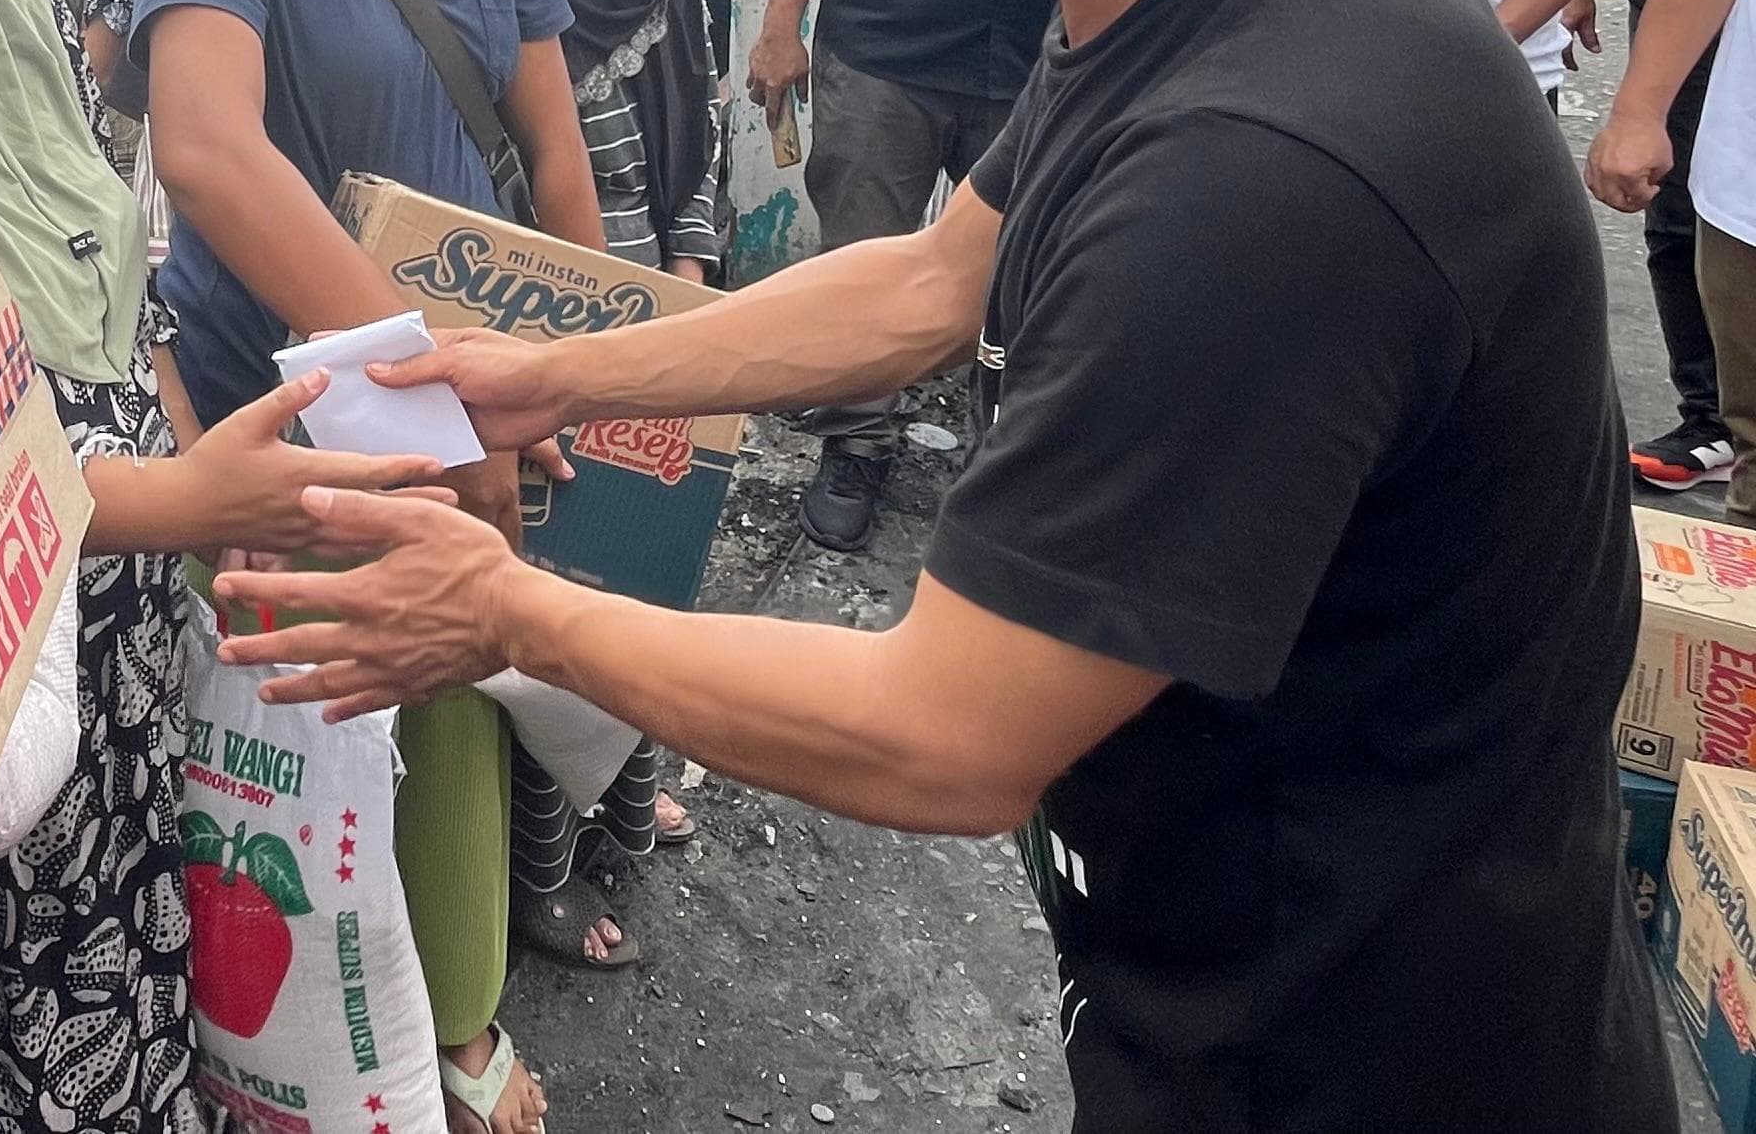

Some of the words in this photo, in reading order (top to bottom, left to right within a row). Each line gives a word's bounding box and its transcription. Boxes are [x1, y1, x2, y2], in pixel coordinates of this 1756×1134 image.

[507, 248, 533, 268] mi
[536, 258, 599, 291] instan
[7, 449, 30, 490] broken
[0, 475, 16, 513] seal
[223, 728, 306, 797] WANGI
[1630, 733, 1657, 759] 9
[337, 910, 364, 980] SUPER
[344, 983, 379, 1074] MEDIUM
